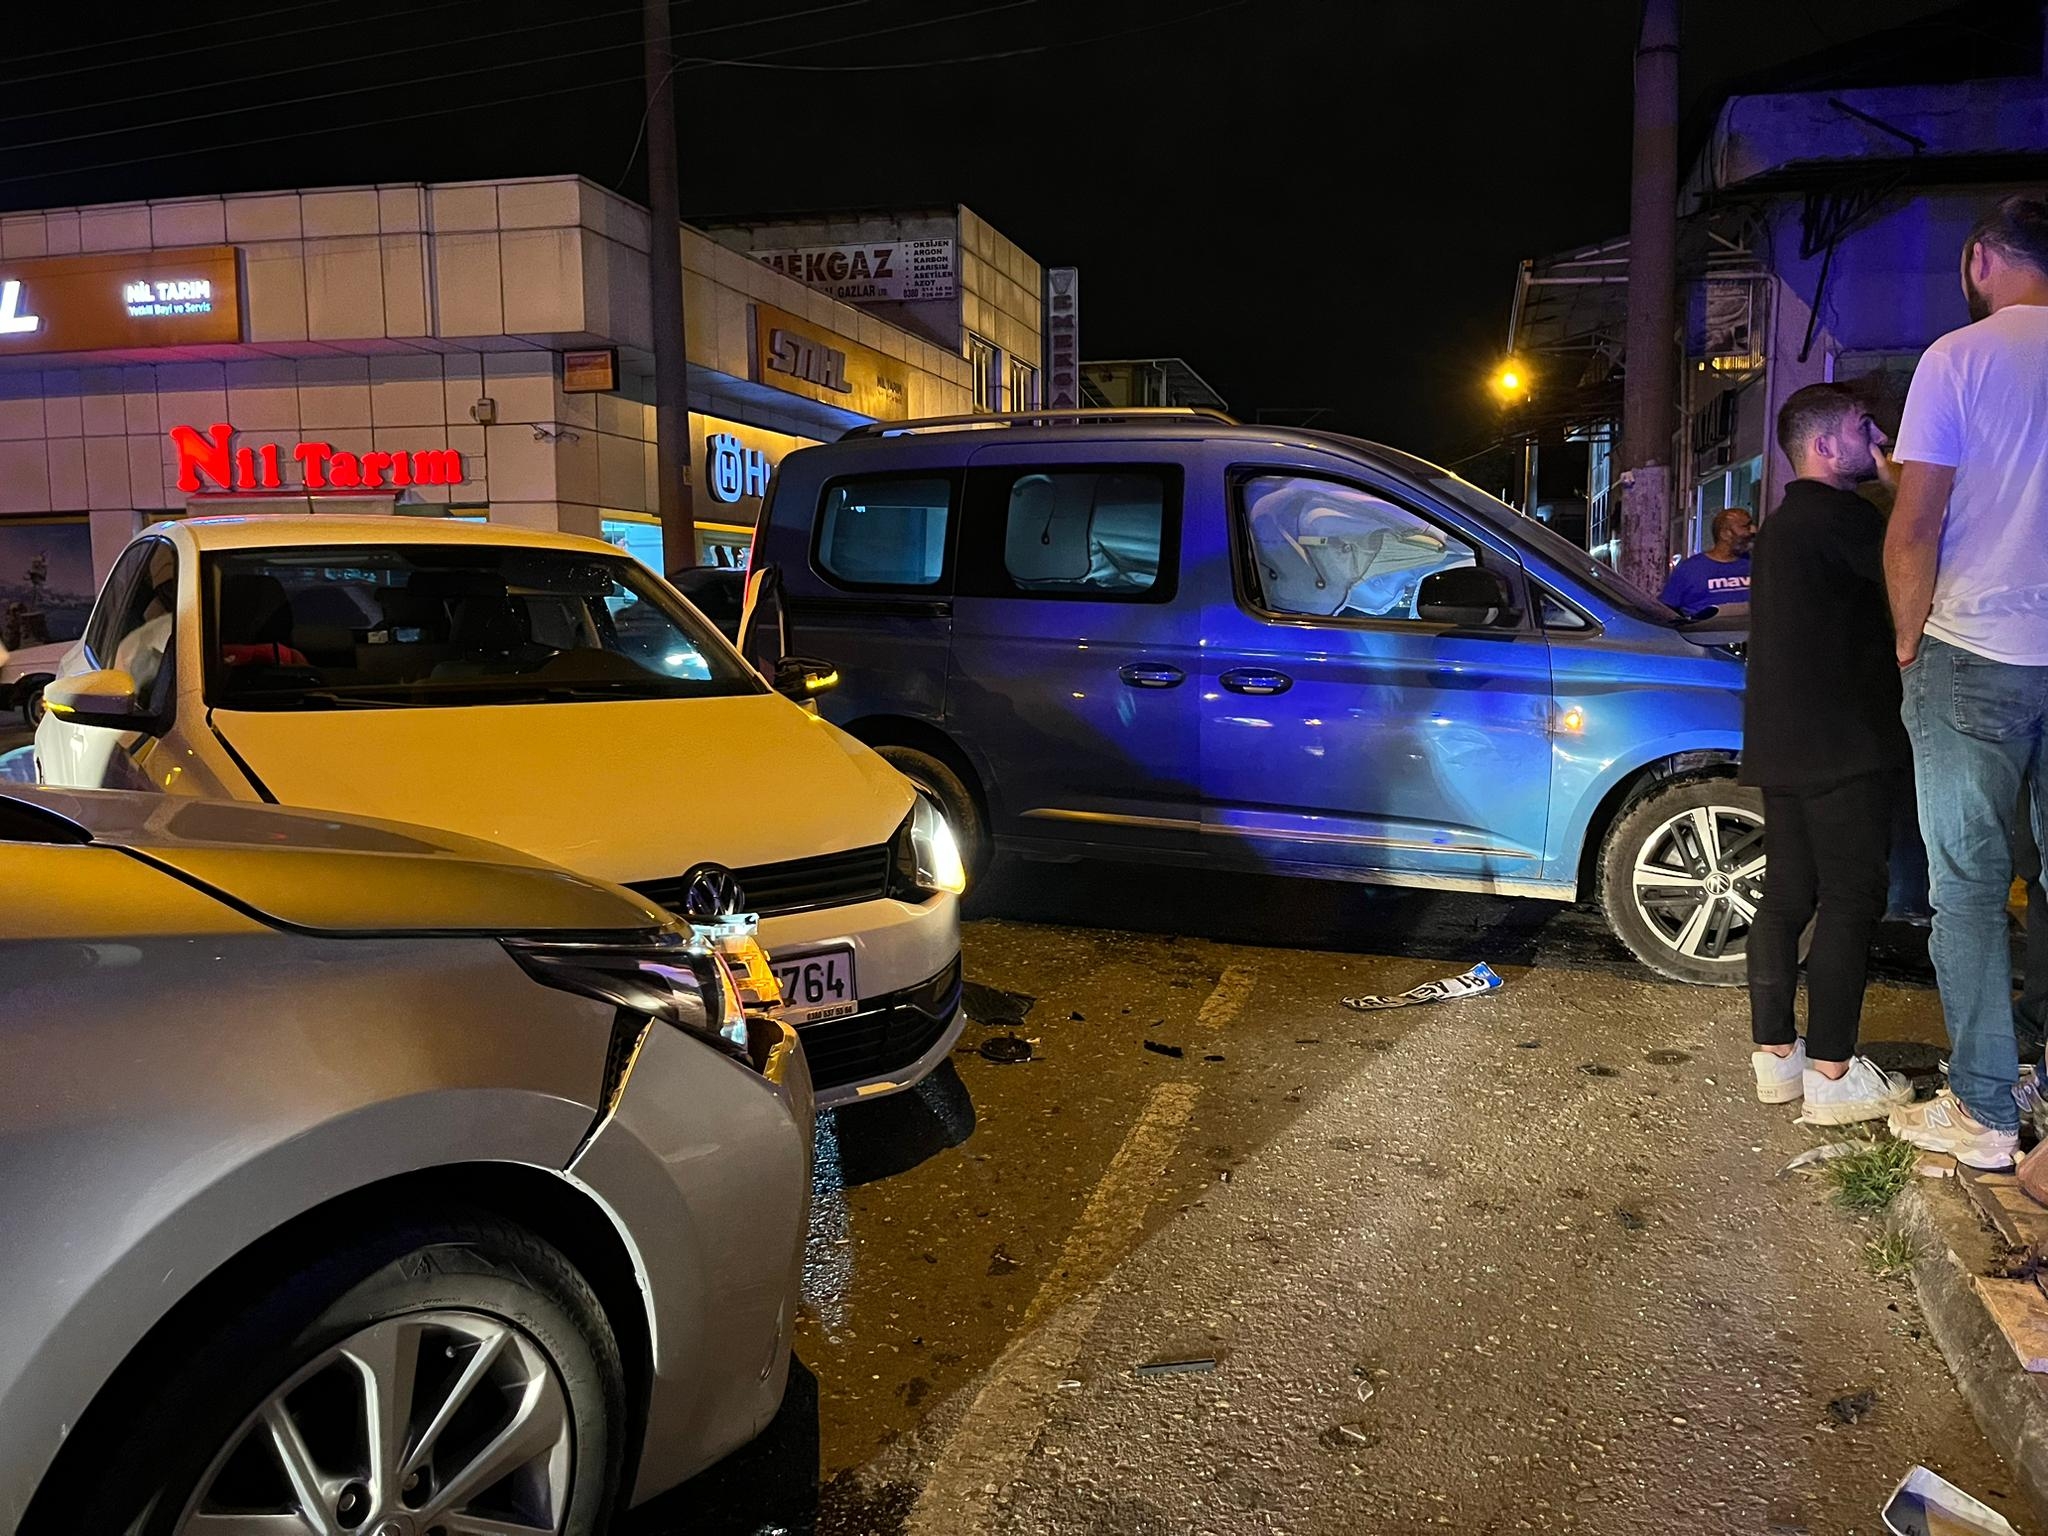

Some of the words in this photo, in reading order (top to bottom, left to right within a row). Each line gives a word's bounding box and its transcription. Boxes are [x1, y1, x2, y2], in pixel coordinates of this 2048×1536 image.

[156, 280, 210, 301] TARIM
[838, 285, 875, 297] GAZLAR
[185, 302, 211, 313] Servis
[1051, 272, 1074, 407] VEMEKGA
[170, 423, 281, 492] Nil
[771, 959, 845, 1004] 764
